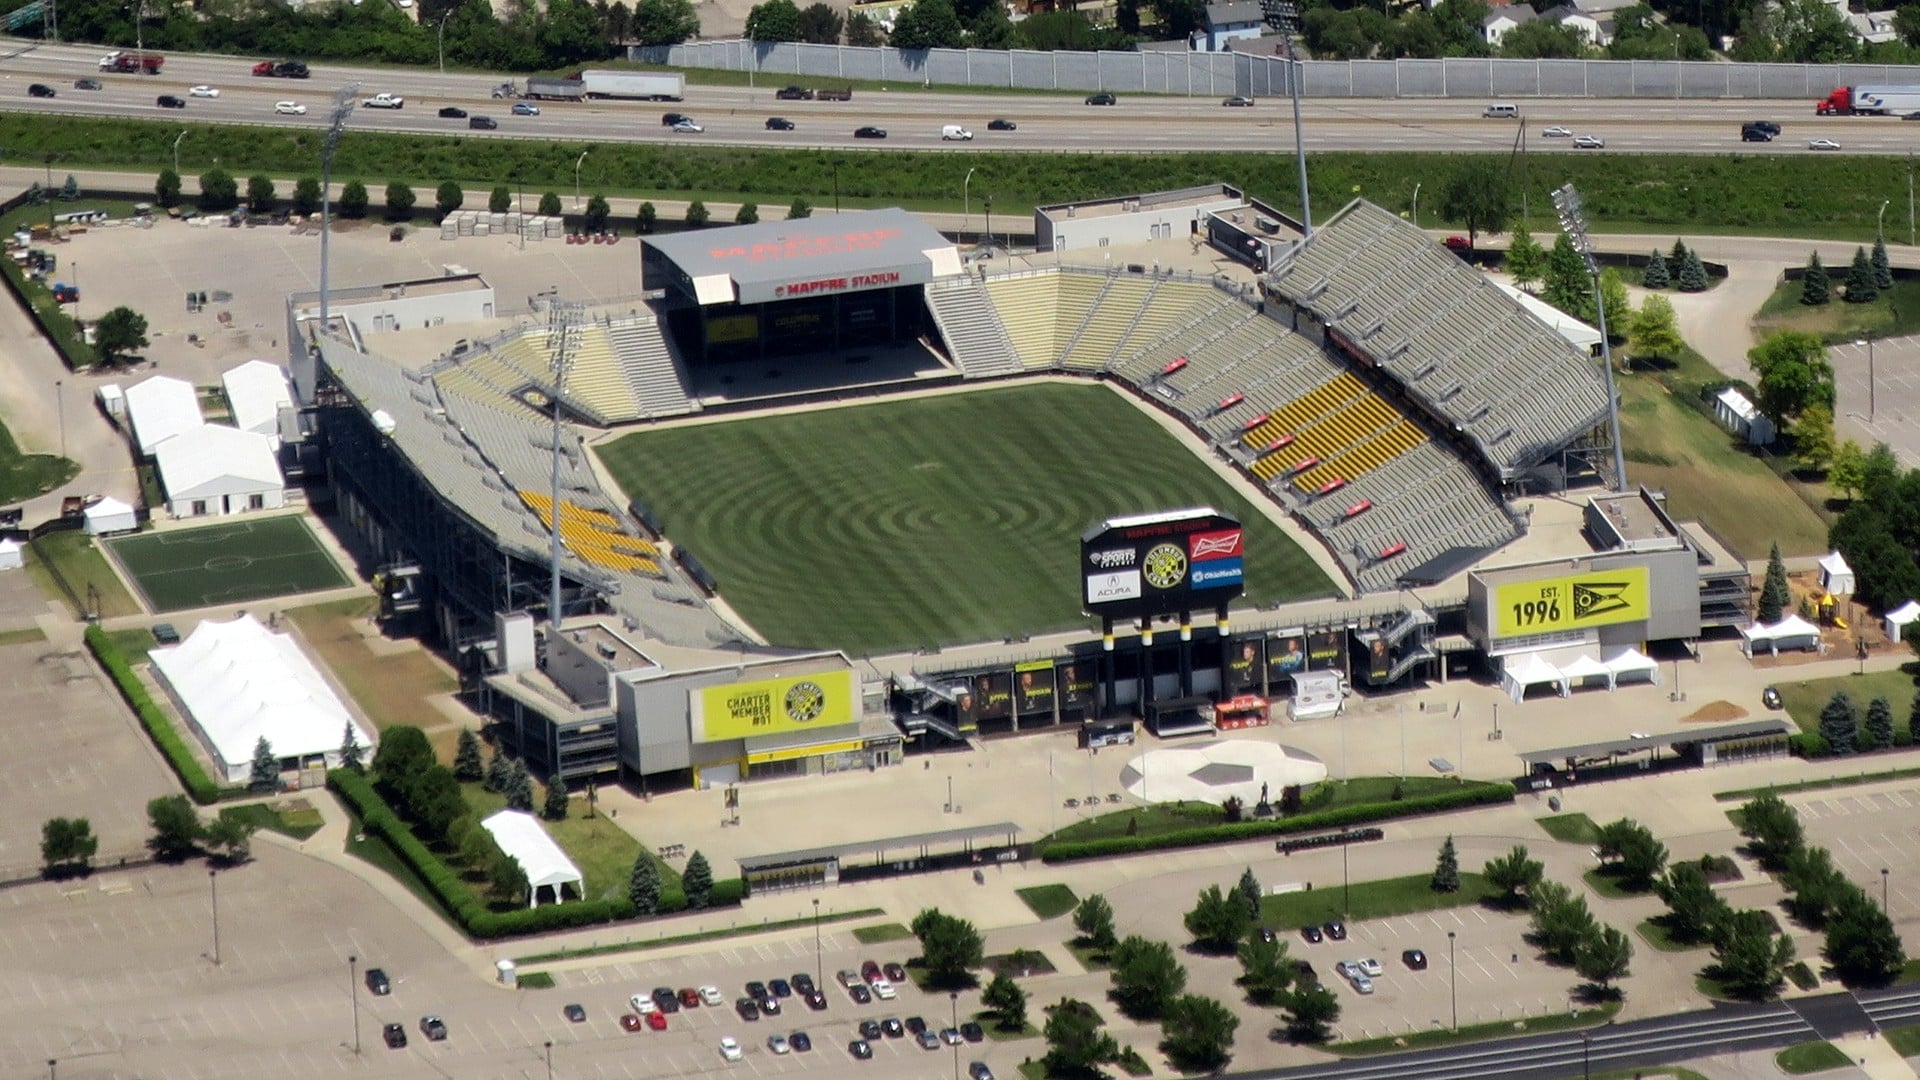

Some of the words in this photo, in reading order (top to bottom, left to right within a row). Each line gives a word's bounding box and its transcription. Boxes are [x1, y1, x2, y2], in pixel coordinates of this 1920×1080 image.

[787, 278, 847, 294] MAPFRE
[852, 272, 899, 288] STADIUM
[1101, 552, 1136, 562] SPORTS
[1147, 546, 1183, 565] COLUMBUS
[1148, 572, 1169, 585] CREW
[1097, 586, 1131, 597] ACURA
[1540, 587, 1561, 599] EST.
[1513, 599, 1561, 627] 1996
[726, 693, 771, 708] CHARTER
[731, 706, 771, 719] MEMBER
[752, 715, 771, 727] #01
